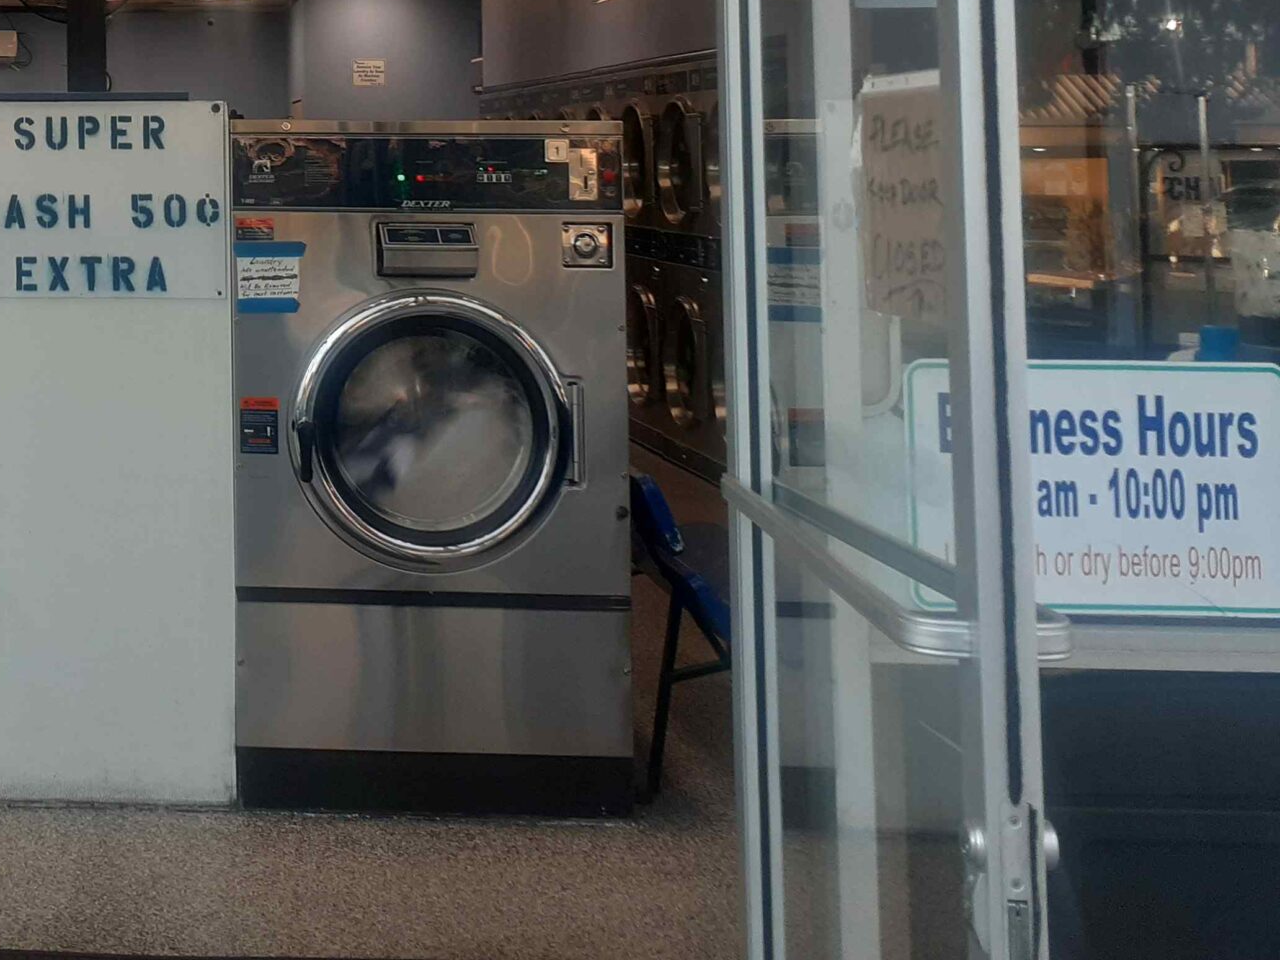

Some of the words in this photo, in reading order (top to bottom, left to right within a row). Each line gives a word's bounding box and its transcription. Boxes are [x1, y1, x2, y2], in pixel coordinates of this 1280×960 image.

[13, 115, 166, 151] SUPER
[554, 146, 560, 156] 1
[131, 193, 220, 229] 50¢
[400, 200, 451, 208] DEXTER
[15, 256, 168, 292] EXTRA
[1136, 394, 1260, 459] Hours
[1037, 479, 1078, 518] am
[1108, 467, 1185, 520] 10:00
[1197, 479, 1239, 533] pm
[1055, 551, 1075, 577] or
[1081, 545, 1112, 584] dry
[1118, 545, 1181, 578] before
[1188, 546, 1263, 586] 9:00pm
